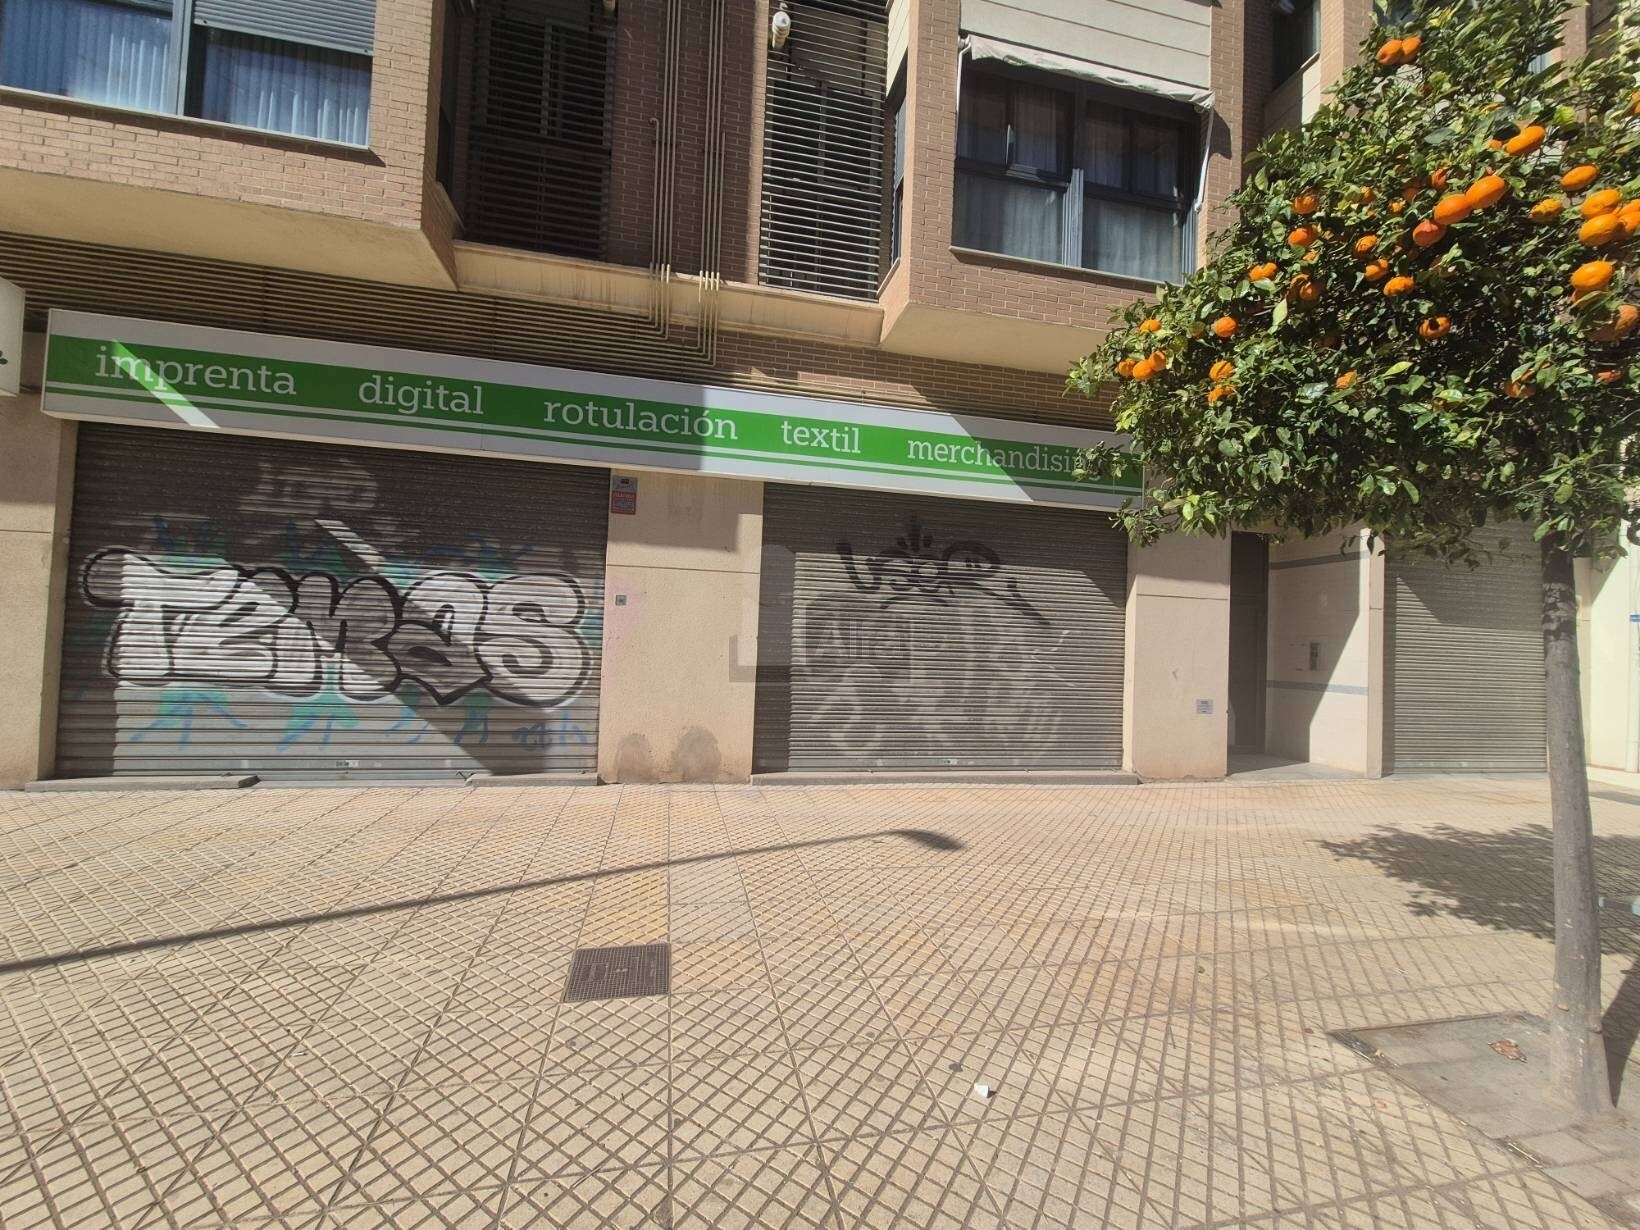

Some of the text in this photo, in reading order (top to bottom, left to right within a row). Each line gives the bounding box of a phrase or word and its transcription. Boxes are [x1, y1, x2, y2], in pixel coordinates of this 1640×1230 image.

[95, 345, 1101, 481] imprenta digital rotulación textil merchandisi
